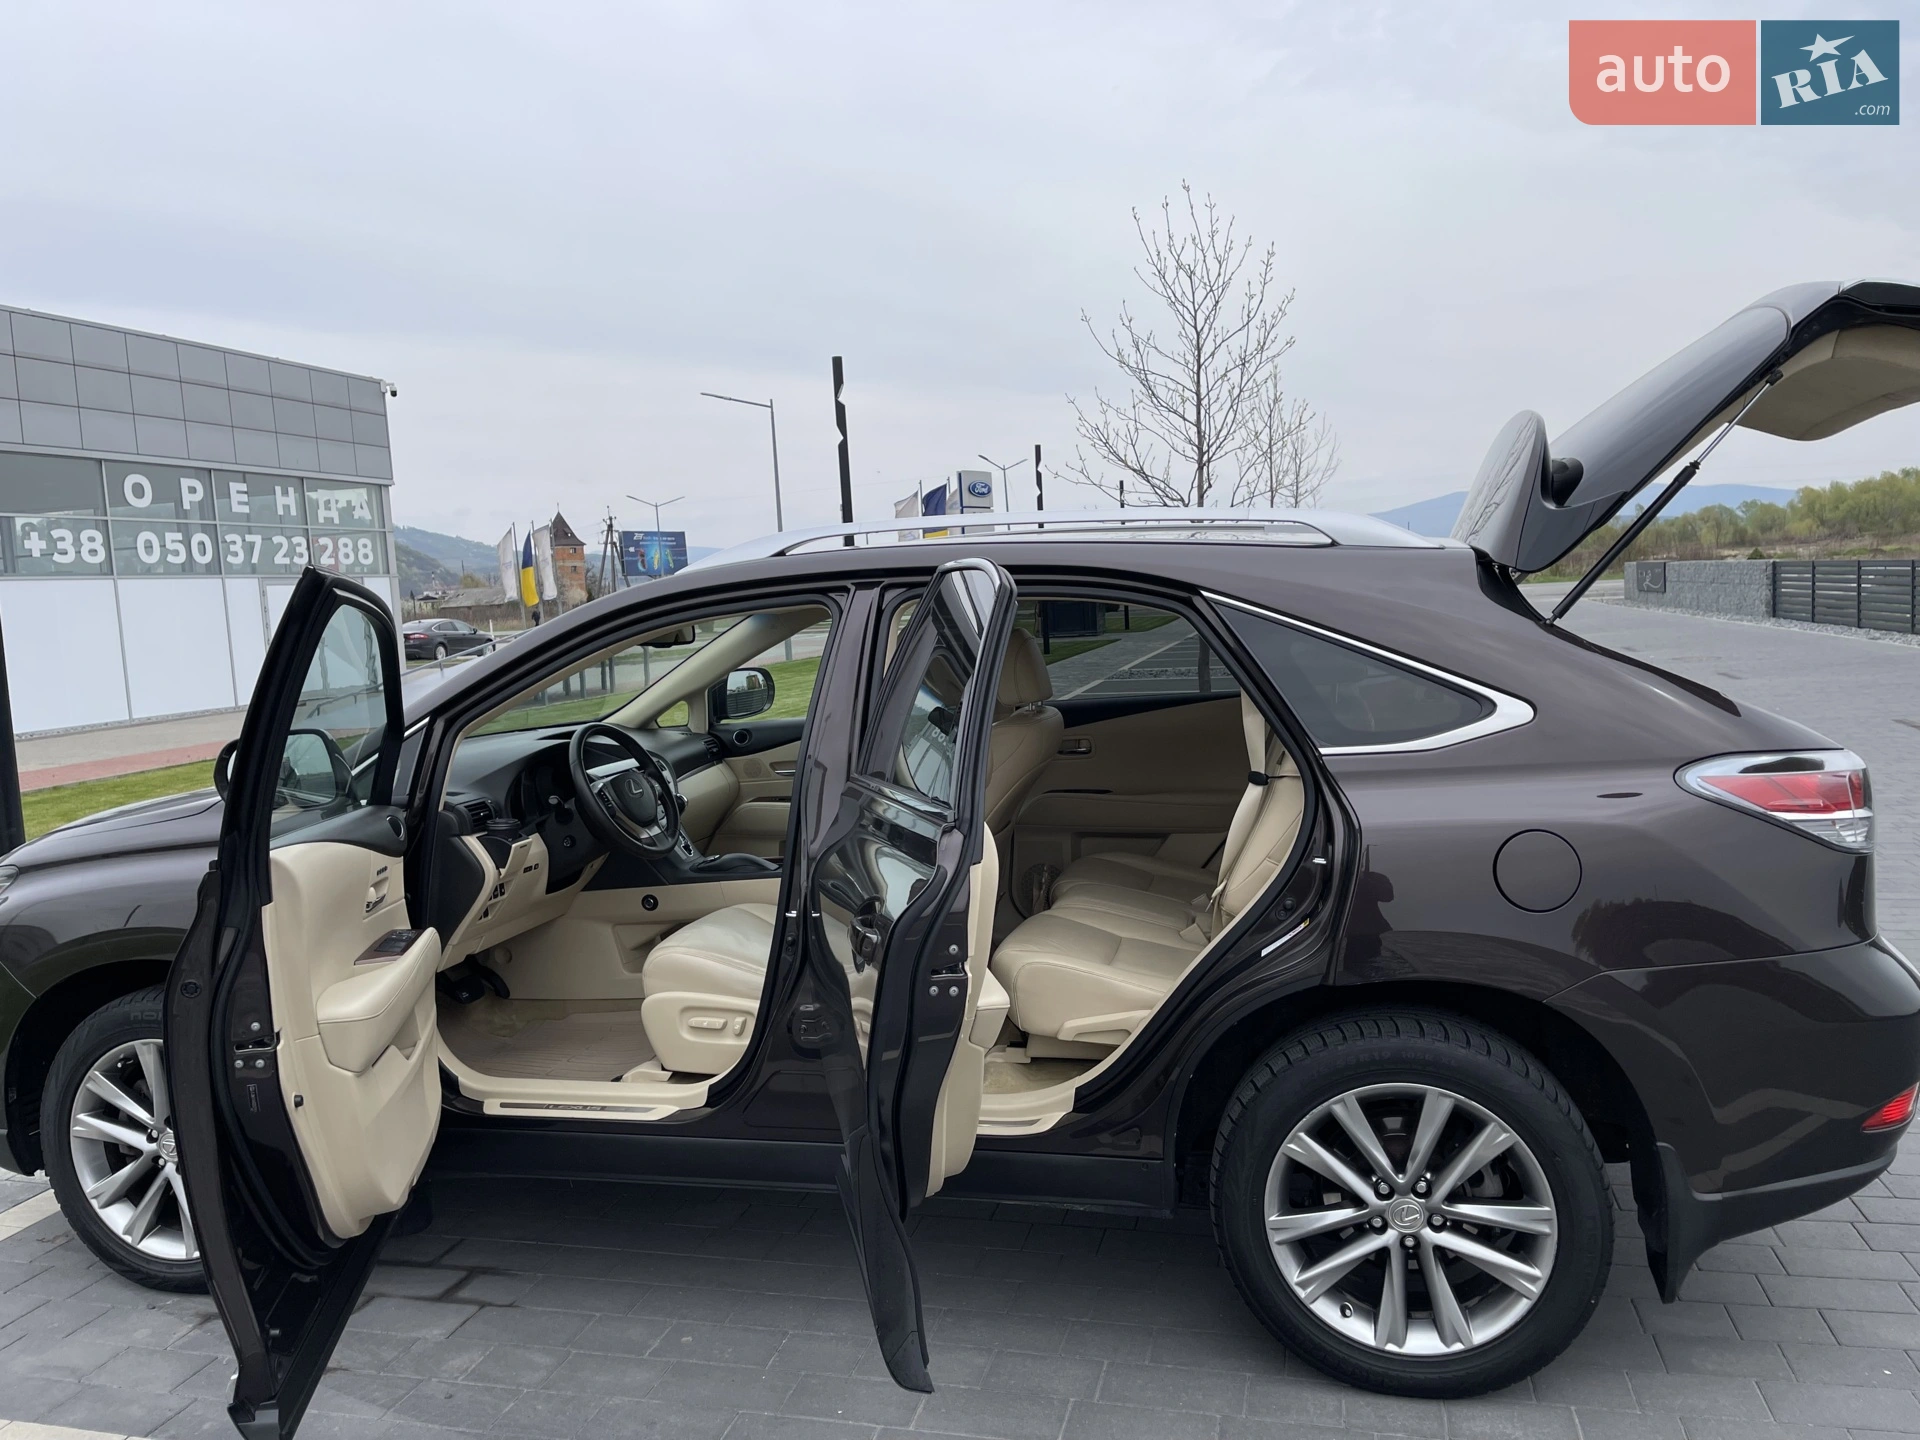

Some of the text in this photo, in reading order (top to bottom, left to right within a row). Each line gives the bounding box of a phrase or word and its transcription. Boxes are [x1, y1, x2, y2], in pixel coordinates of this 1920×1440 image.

[23, 528, 106, 564] +38
[136, 530, 213, 564] 050
[318, 537, 374, 565] 288
